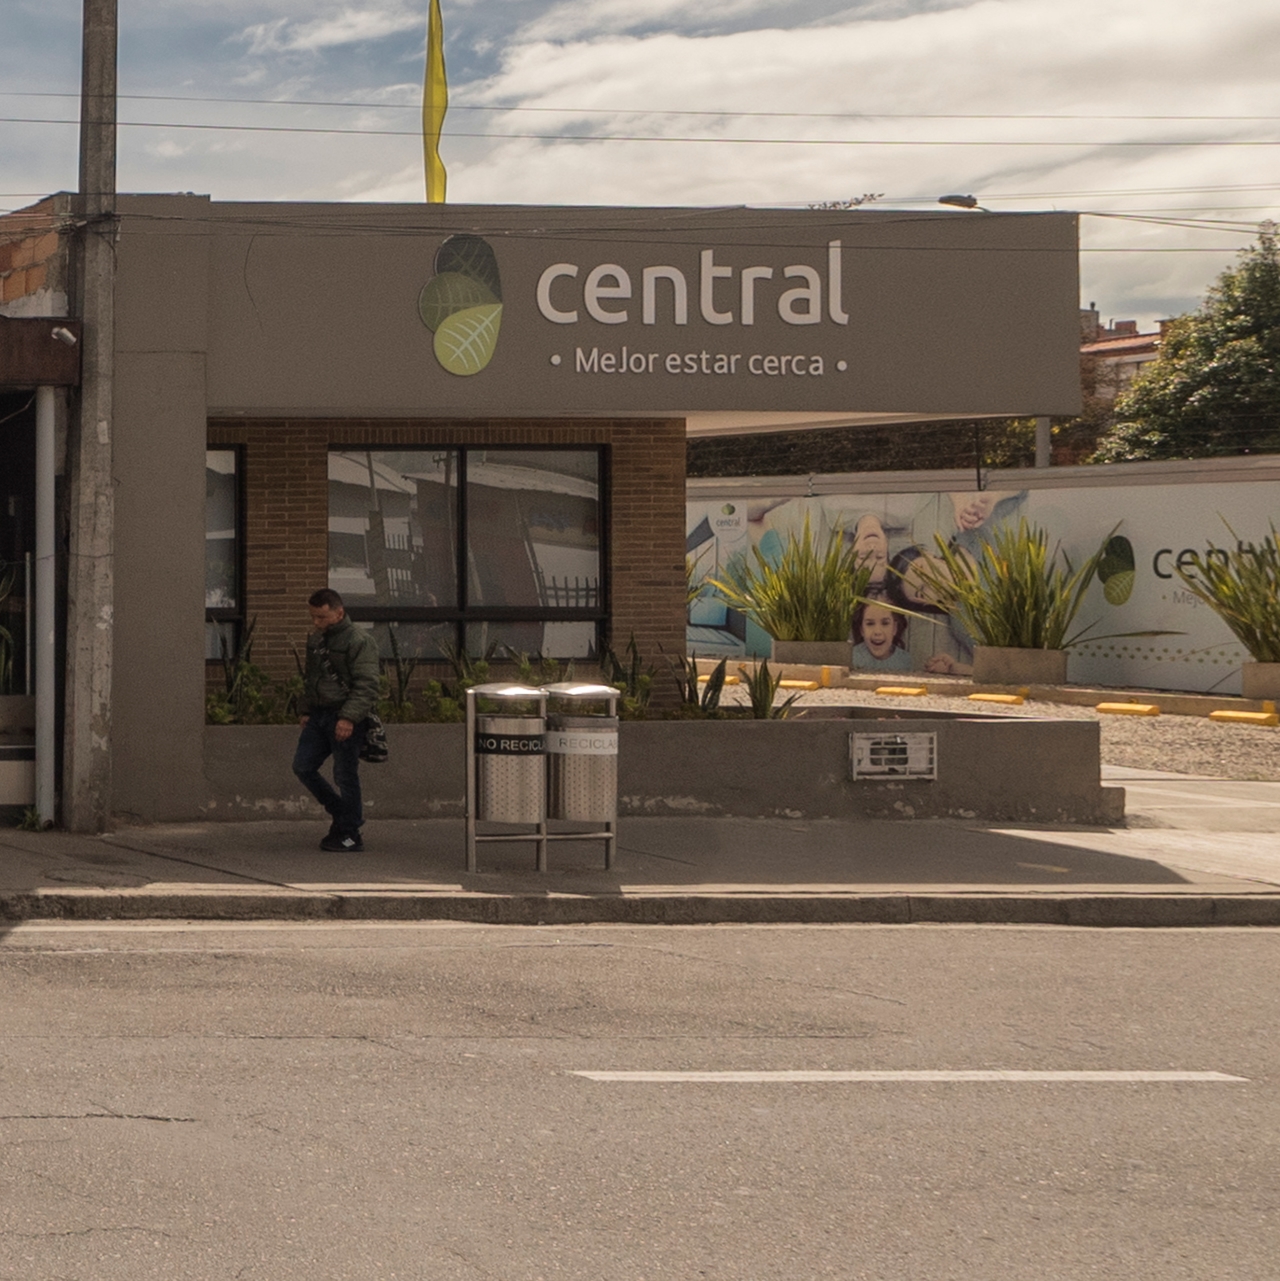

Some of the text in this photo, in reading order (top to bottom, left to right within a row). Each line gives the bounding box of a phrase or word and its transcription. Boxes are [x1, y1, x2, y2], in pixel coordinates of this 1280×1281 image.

[537, 240, 849, 325] central
[665, 350, 741, 374] estar
[749, 354, 824, 376] cerca
[479, 738, 497, 750] NO
